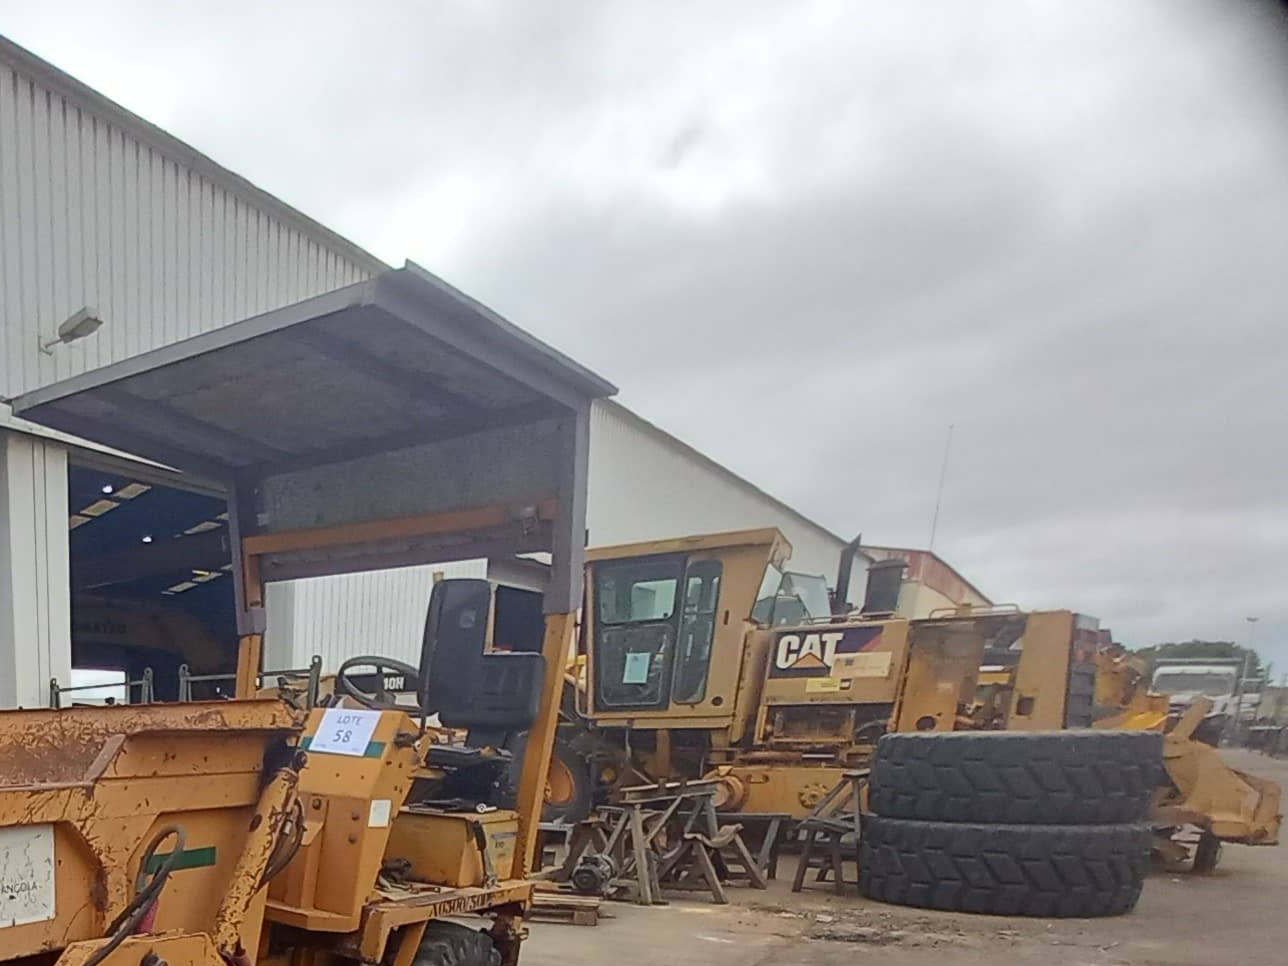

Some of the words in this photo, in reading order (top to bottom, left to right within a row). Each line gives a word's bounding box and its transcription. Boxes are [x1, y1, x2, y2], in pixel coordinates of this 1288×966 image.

[776, 633, 844, 669] CAT
[337, 715, 363, 726] LOTE
[332, 729, 353, 743] 58
